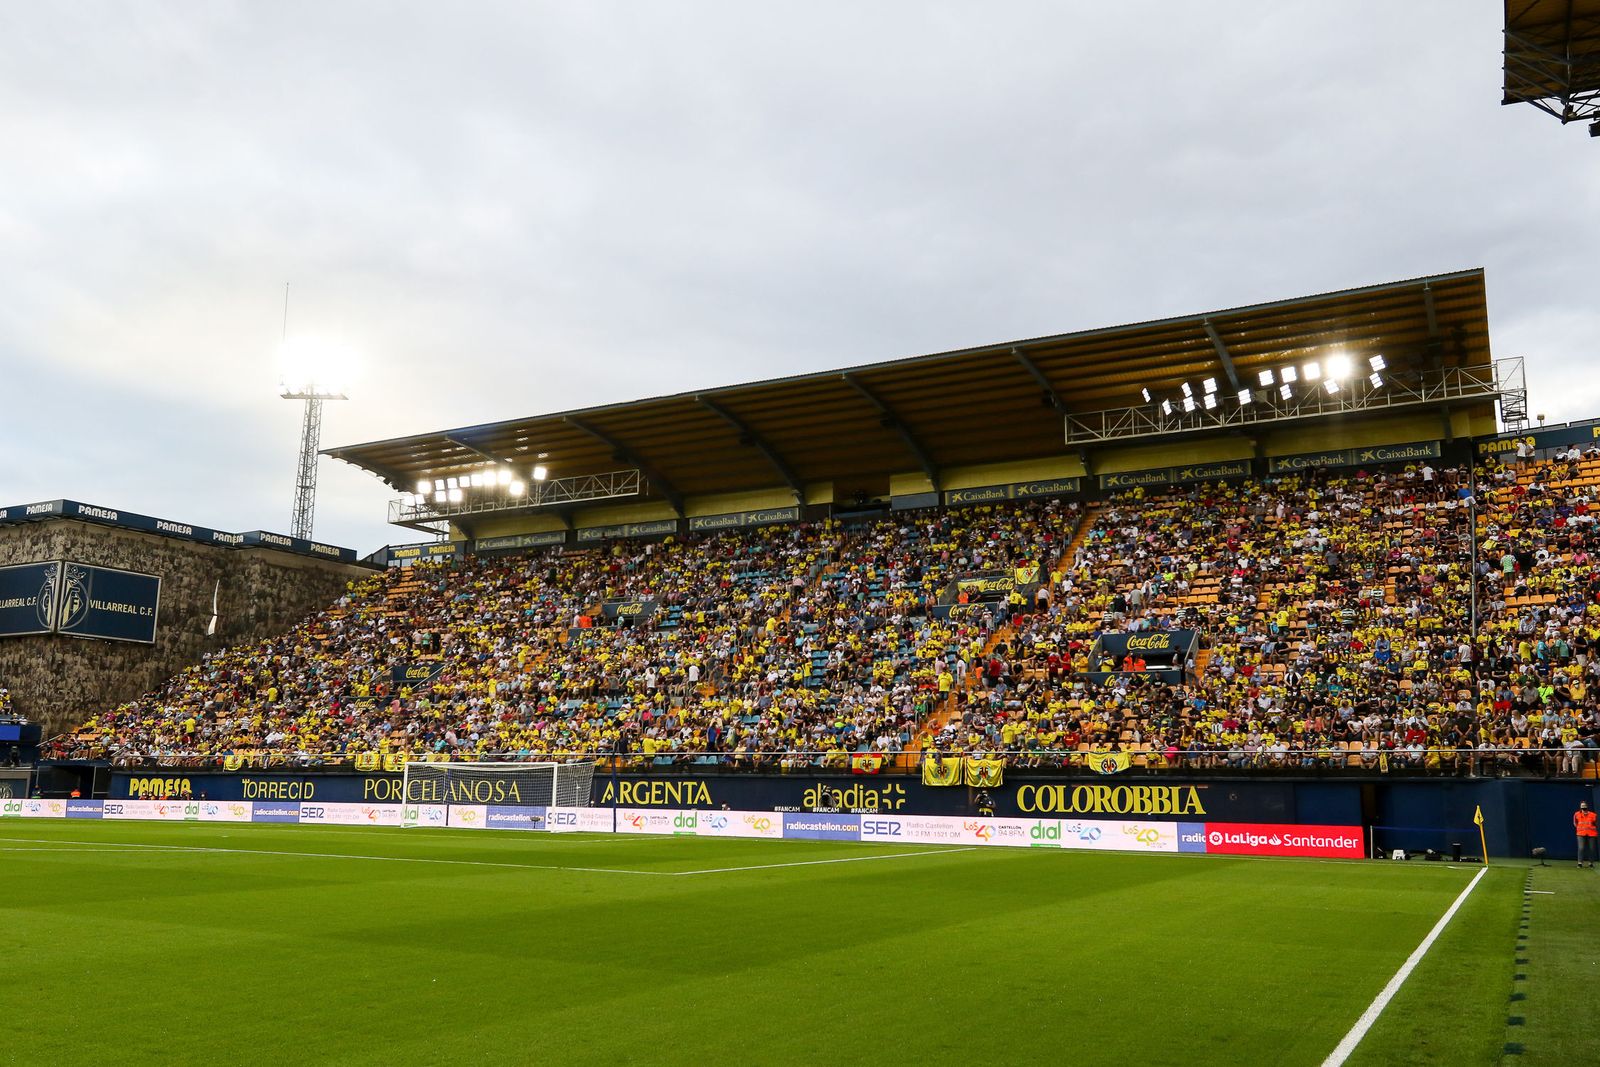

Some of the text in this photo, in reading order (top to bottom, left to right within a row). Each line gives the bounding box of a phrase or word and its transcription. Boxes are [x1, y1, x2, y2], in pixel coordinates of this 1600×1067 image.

[1478, 436, 1536, 454] PAMEA
[1376, 445, 1432, 460] CaixaBank
[1292, 455, 1344, 467] CaixaBank
[1120, 473, 1167, 485] CaixaBank
[1194, 466, 1244, 478] CaixaBank
[1029, 482, 1073, 494] CaixaBank
[963, 490, 1005, 501] CaixaBank
[26, 503, 53, 516] PAMESA
[78, 505, 118, 521] PAMESA
[704, 517, 738, 527] CaixaBank
[757, 512, 793, 522] CaixaBank
[156, 521, 193, 535] PAMESA
[639, 523, 671, 533] CaixaBank
[213, 531, 244, 544] PAMESA
[260, 533, 292, 546] PAMESA
[310, 543, 340, 557] PAMESA
[394, 549, 421, 559] PAMESA
[428, 545, 456, 555] PAMESA
[90, 600, 153, 617] VILLARREAL C.F.
[1126, 633, 1171, 650] Coca-Cola
[129, 778, 192, 798] PAMESA
[242, 779, 315, 799] TORRECID
[364, 779, 521, 803] PORCELANOSA
[600, 781, 713, 805] ARGENTA
[1016, 785, 1206, 815] COLOROBBIA
[301, 807, 325, 818] SER
[673, 811, 698, 829] dial
[787, 822, 859, 832] radiocastellon.com
[863, 820, 901, 836] SER
[1030, 820, 1061, 839] dial
[1225, 832, 1359, 849] LaLiga Santander
